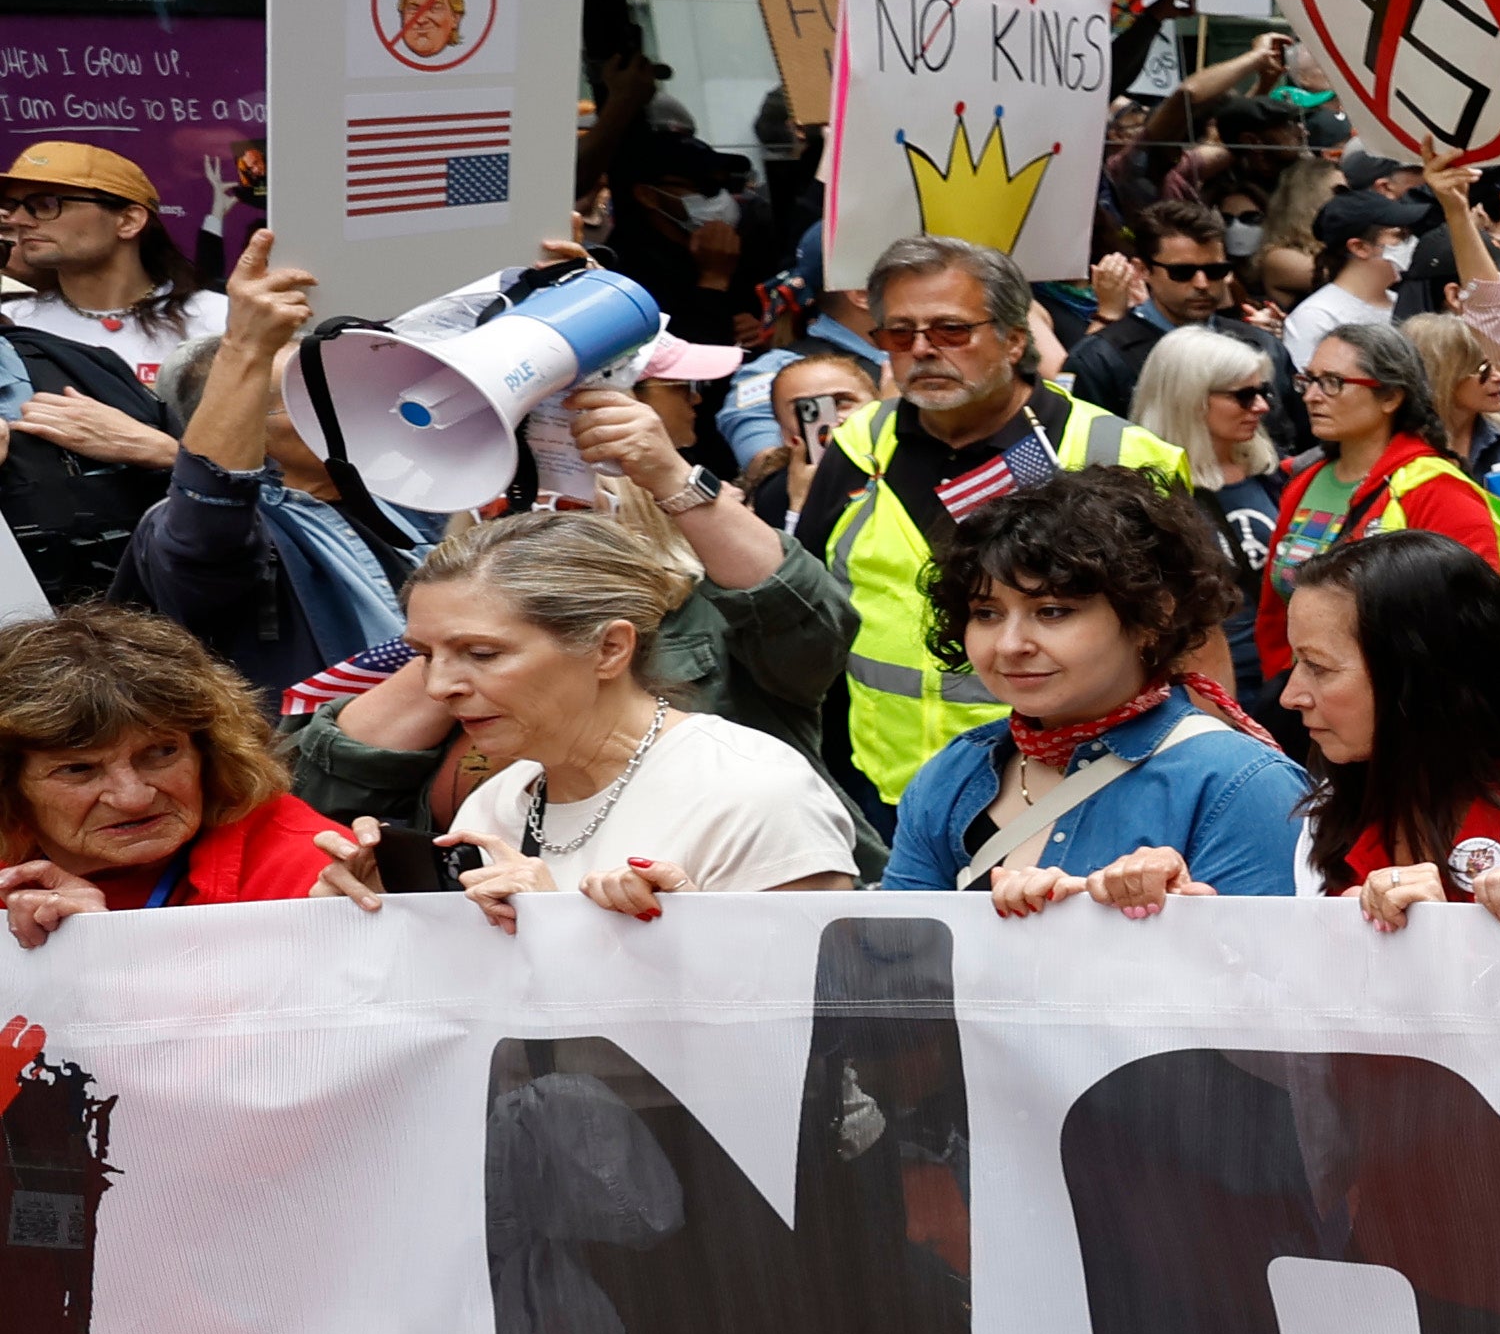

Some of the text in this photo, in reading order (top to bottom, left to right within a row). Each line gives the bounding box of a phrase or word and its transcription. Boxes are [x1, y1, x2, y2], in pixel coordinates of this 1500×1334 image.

[57, 47, 76, 76] I
[84, 45, 143, 77] GROW
[20, 97, 56, 119] am
[64, 93, 135, 120] GOING
[141, 98, 165, 121] TO
[170, 97, 202, 123] BE
[503, 359, 537, 394] PYLE
